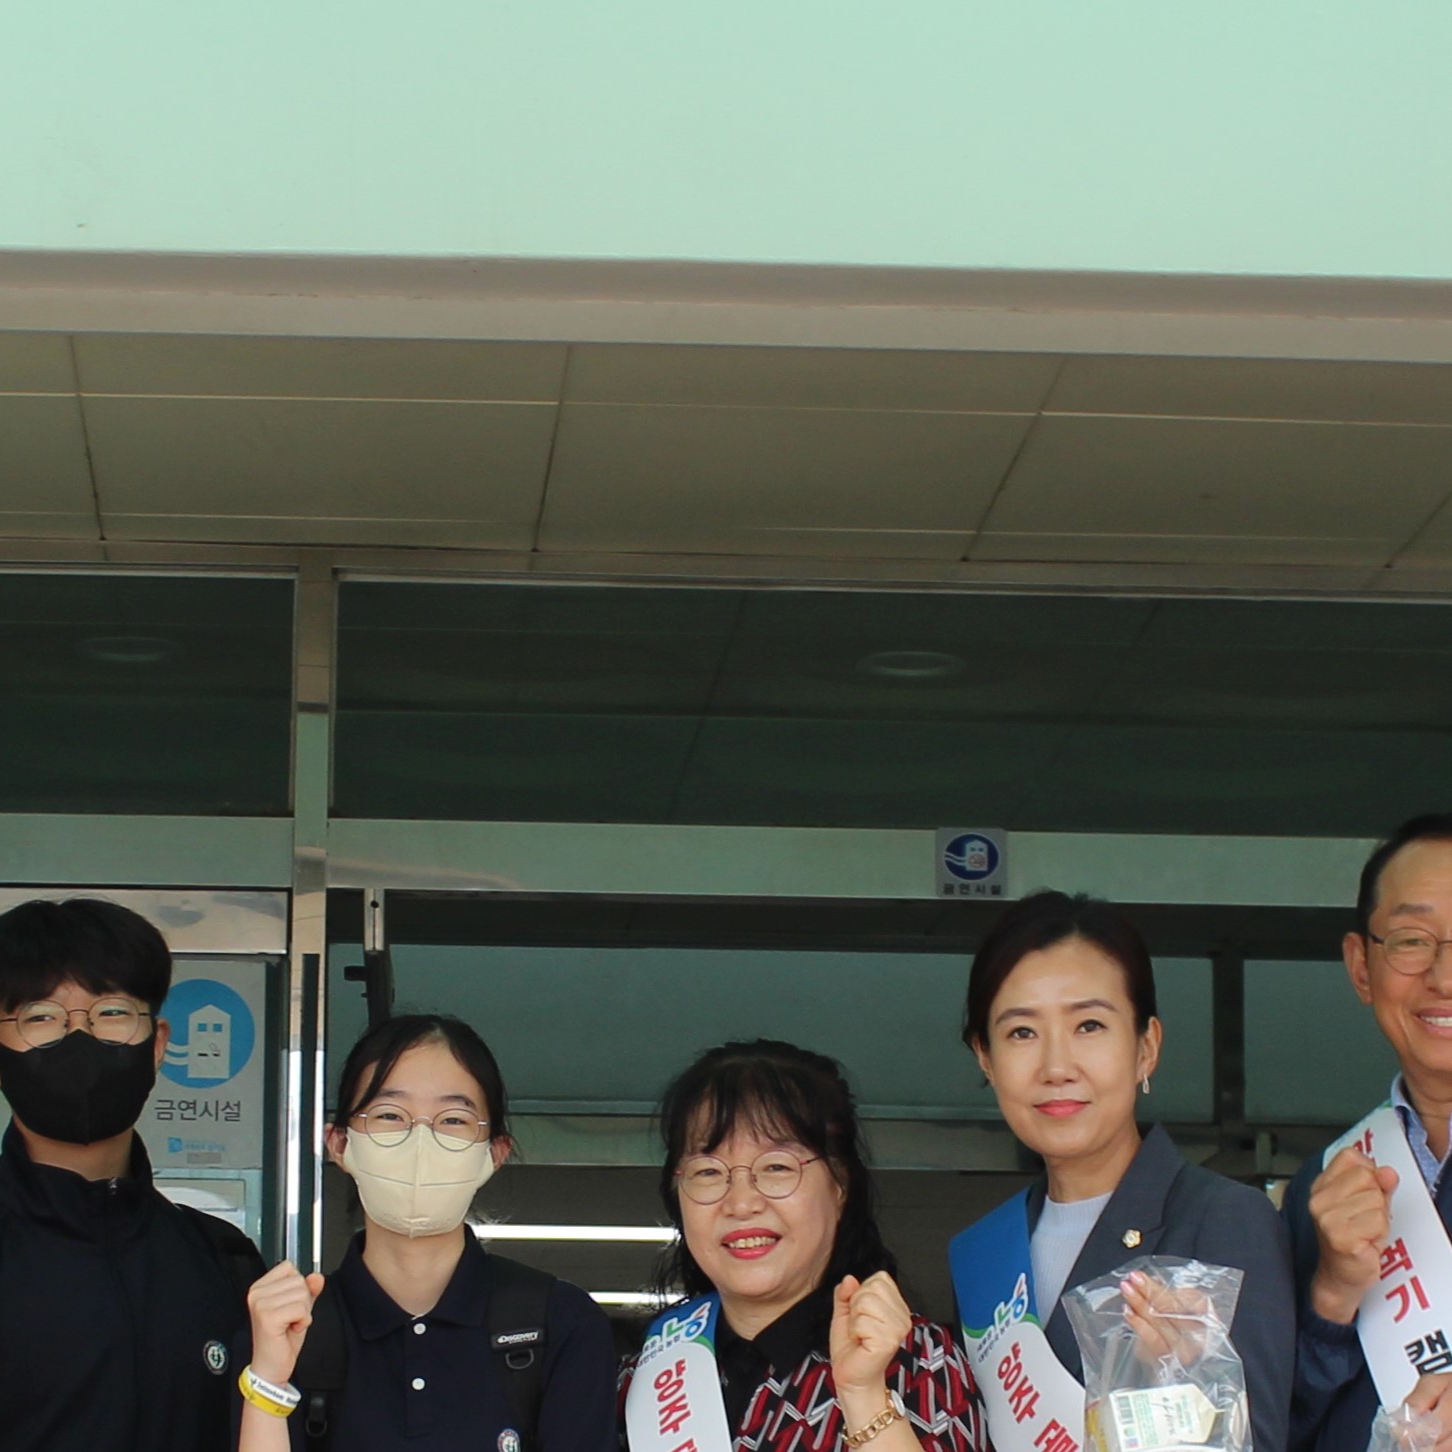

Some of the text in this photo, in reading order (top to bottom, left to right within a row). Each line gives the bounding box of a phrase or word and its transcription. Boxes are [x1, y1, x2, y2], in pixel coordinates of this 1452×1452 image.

[154, 1099, 242, 1123] 금연시설
[652, 1357, 693, 1438] 양주
[996, 1341, 1041, 1424] 양주
